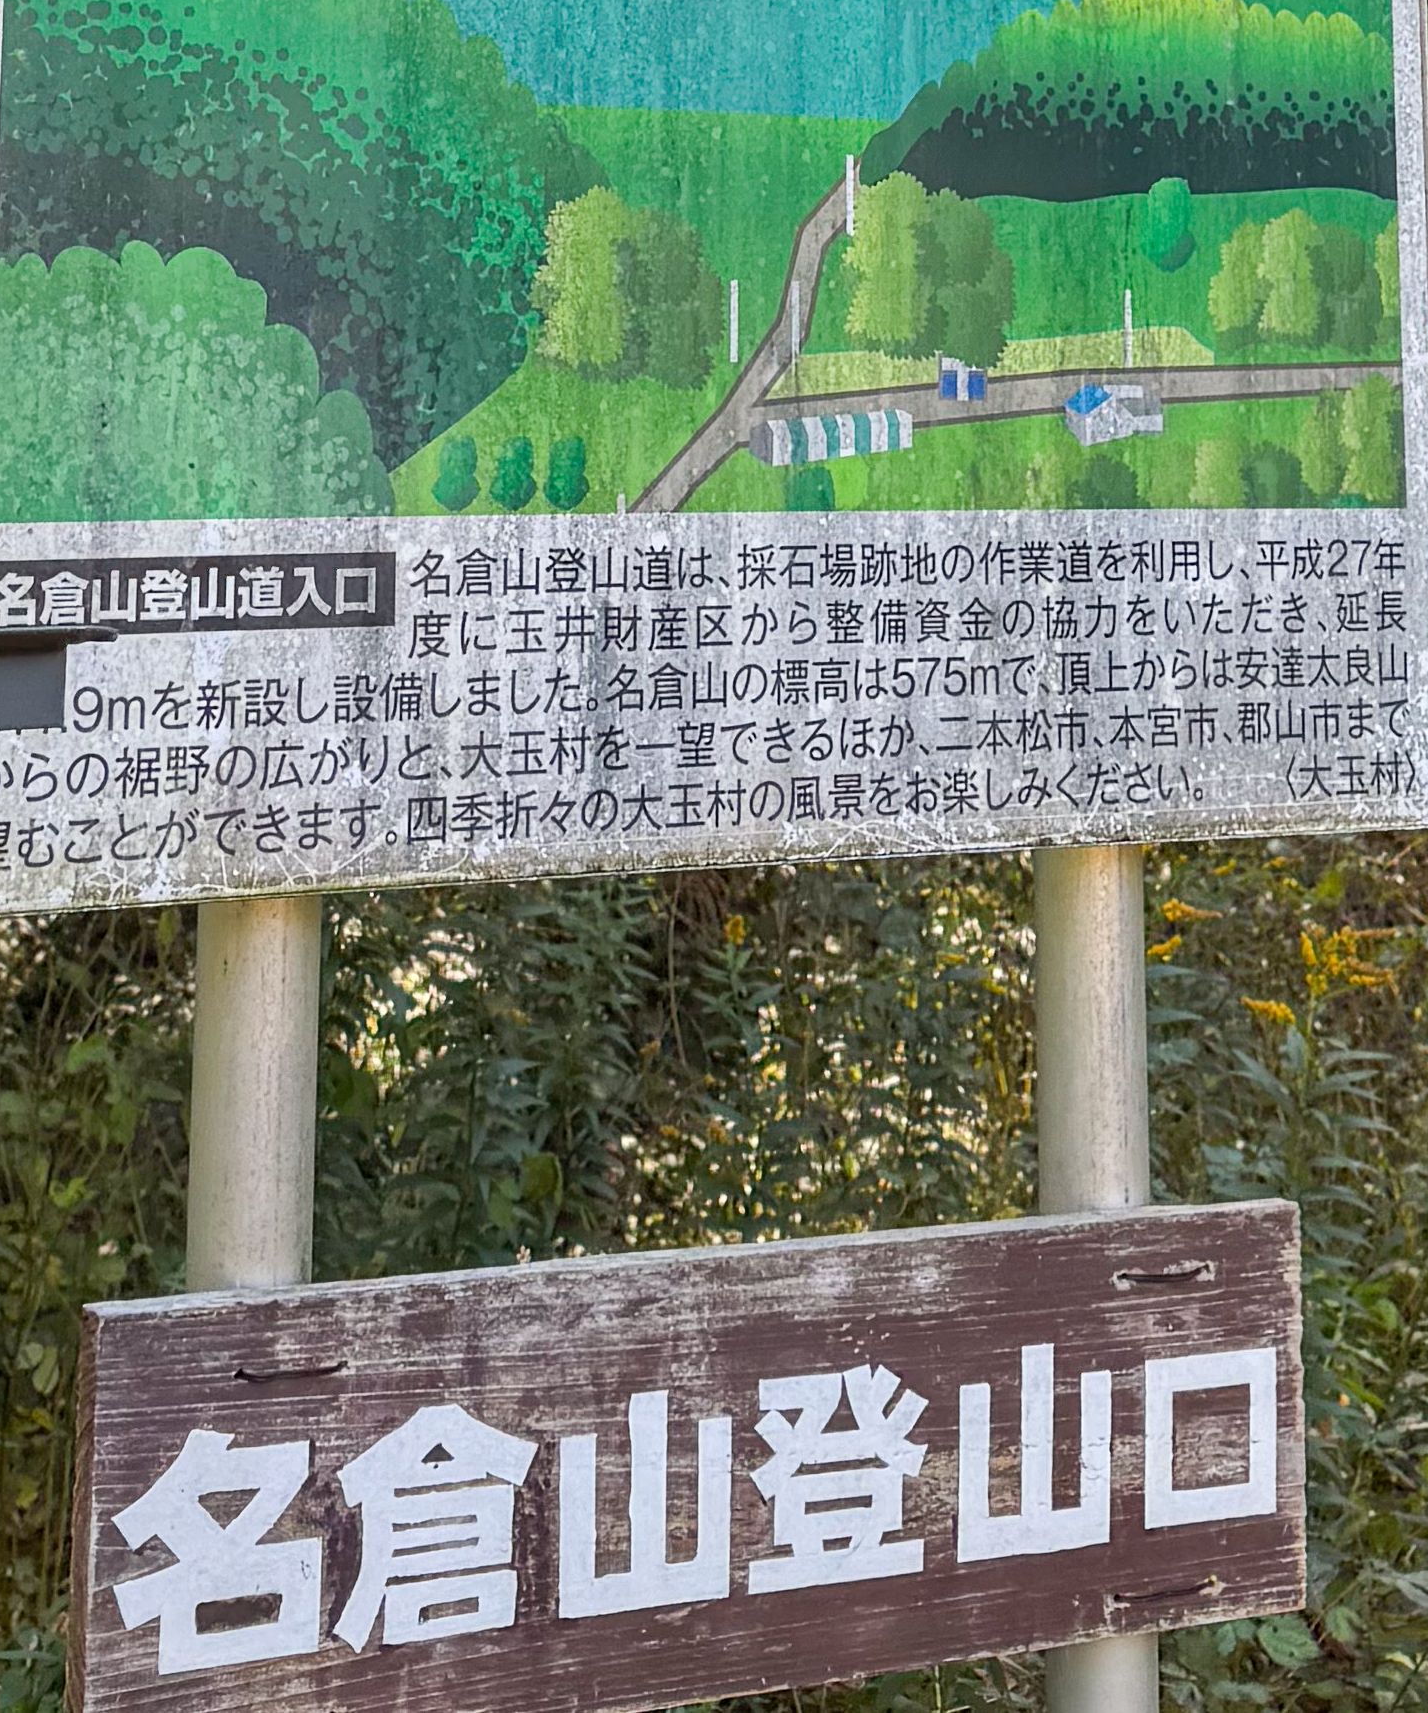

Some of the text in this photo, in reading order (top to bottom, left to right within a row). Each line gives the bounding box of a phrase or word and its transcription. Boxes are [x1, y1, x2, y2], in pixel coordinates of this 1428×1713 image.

[409, 537, 1407, 598] 名倉山登山道は、採石場跡地の作業道を利用し、平成27年
[408, 590, 1408, 659] 度に玉井財産区から整備資金の協力をいただき、延長
[111, 1342, 1278, 1676] 名倉山登山口
